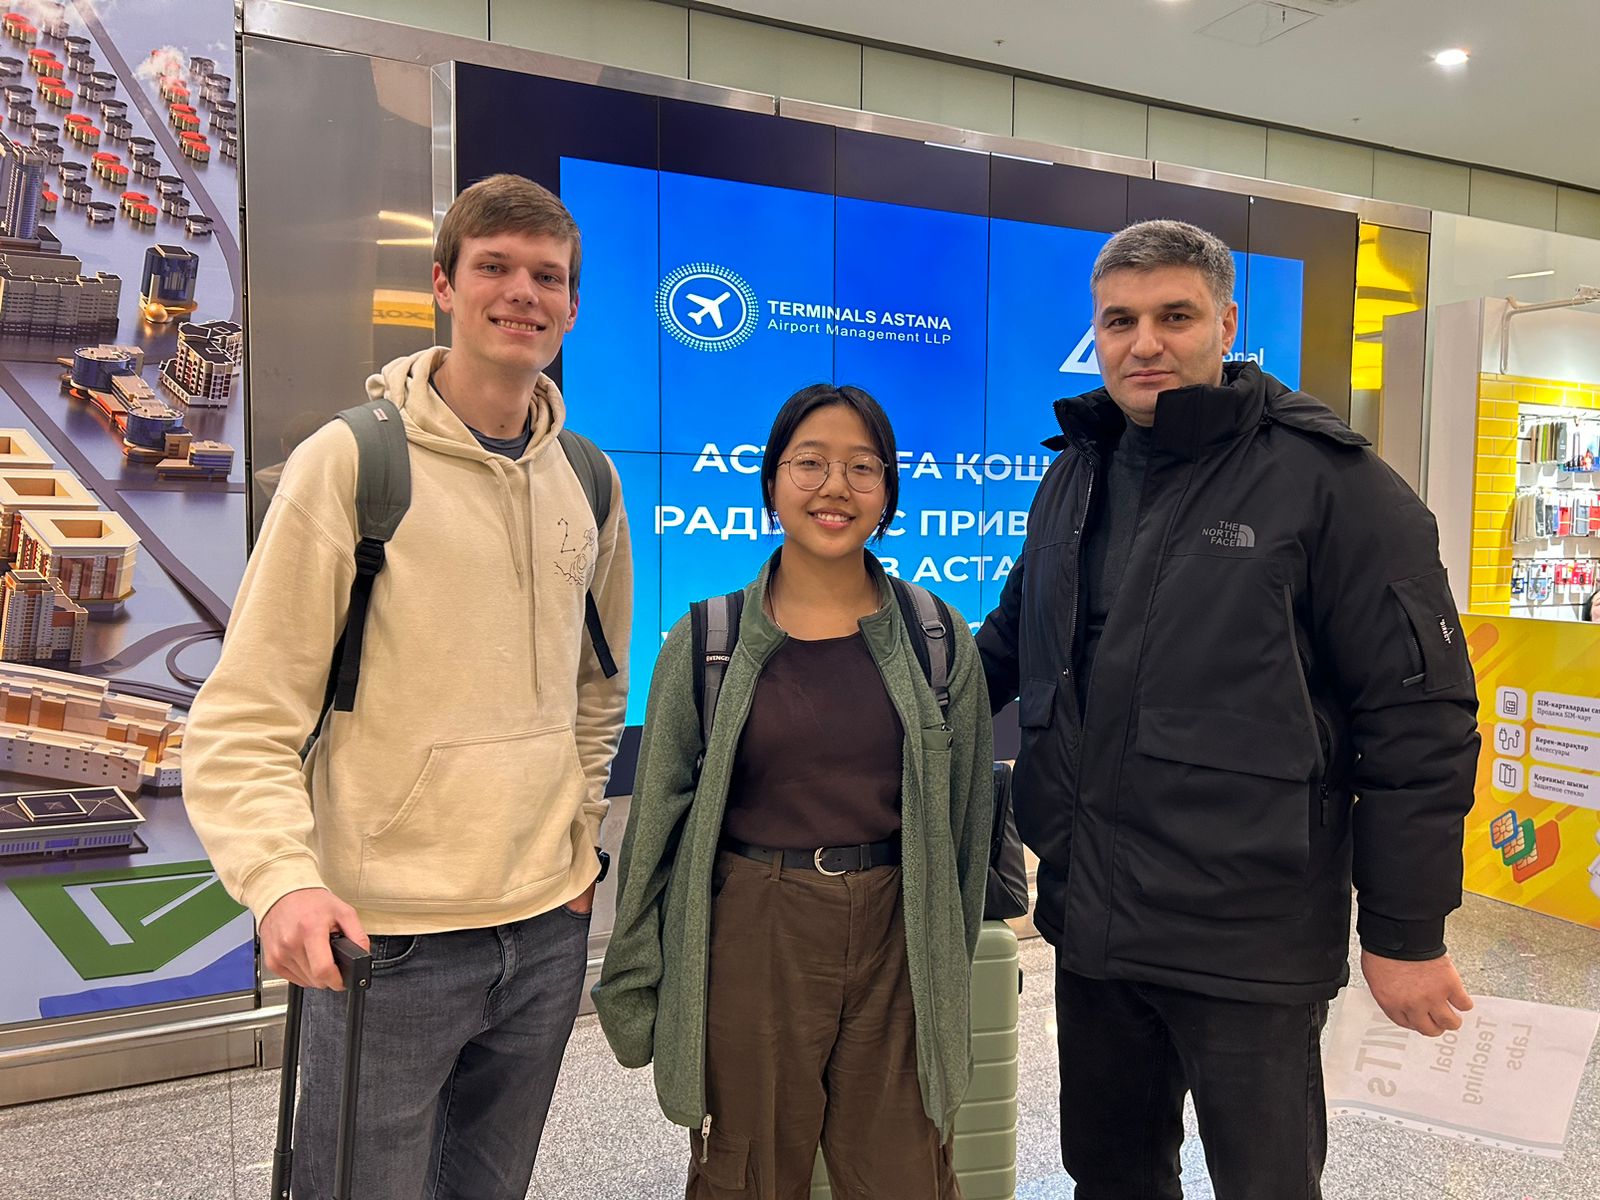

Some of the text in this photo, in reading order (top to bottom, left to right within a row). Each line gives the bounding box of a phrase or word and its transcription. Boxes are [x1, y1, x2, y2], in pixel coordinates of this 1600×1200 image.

[767, 299, 952, 331] TERMINALS ASTANA
[767, 318, 951, 345] Airport Management LLP
[1219, 520, 1240, 532] THE
[1201, 527, 1238, 540] NORTH
[1210, 536, 1236, 547] FACE
[1536, 707, 1564, 718] Продажа
[1535, 745, 1570, 756] Аксессуары
